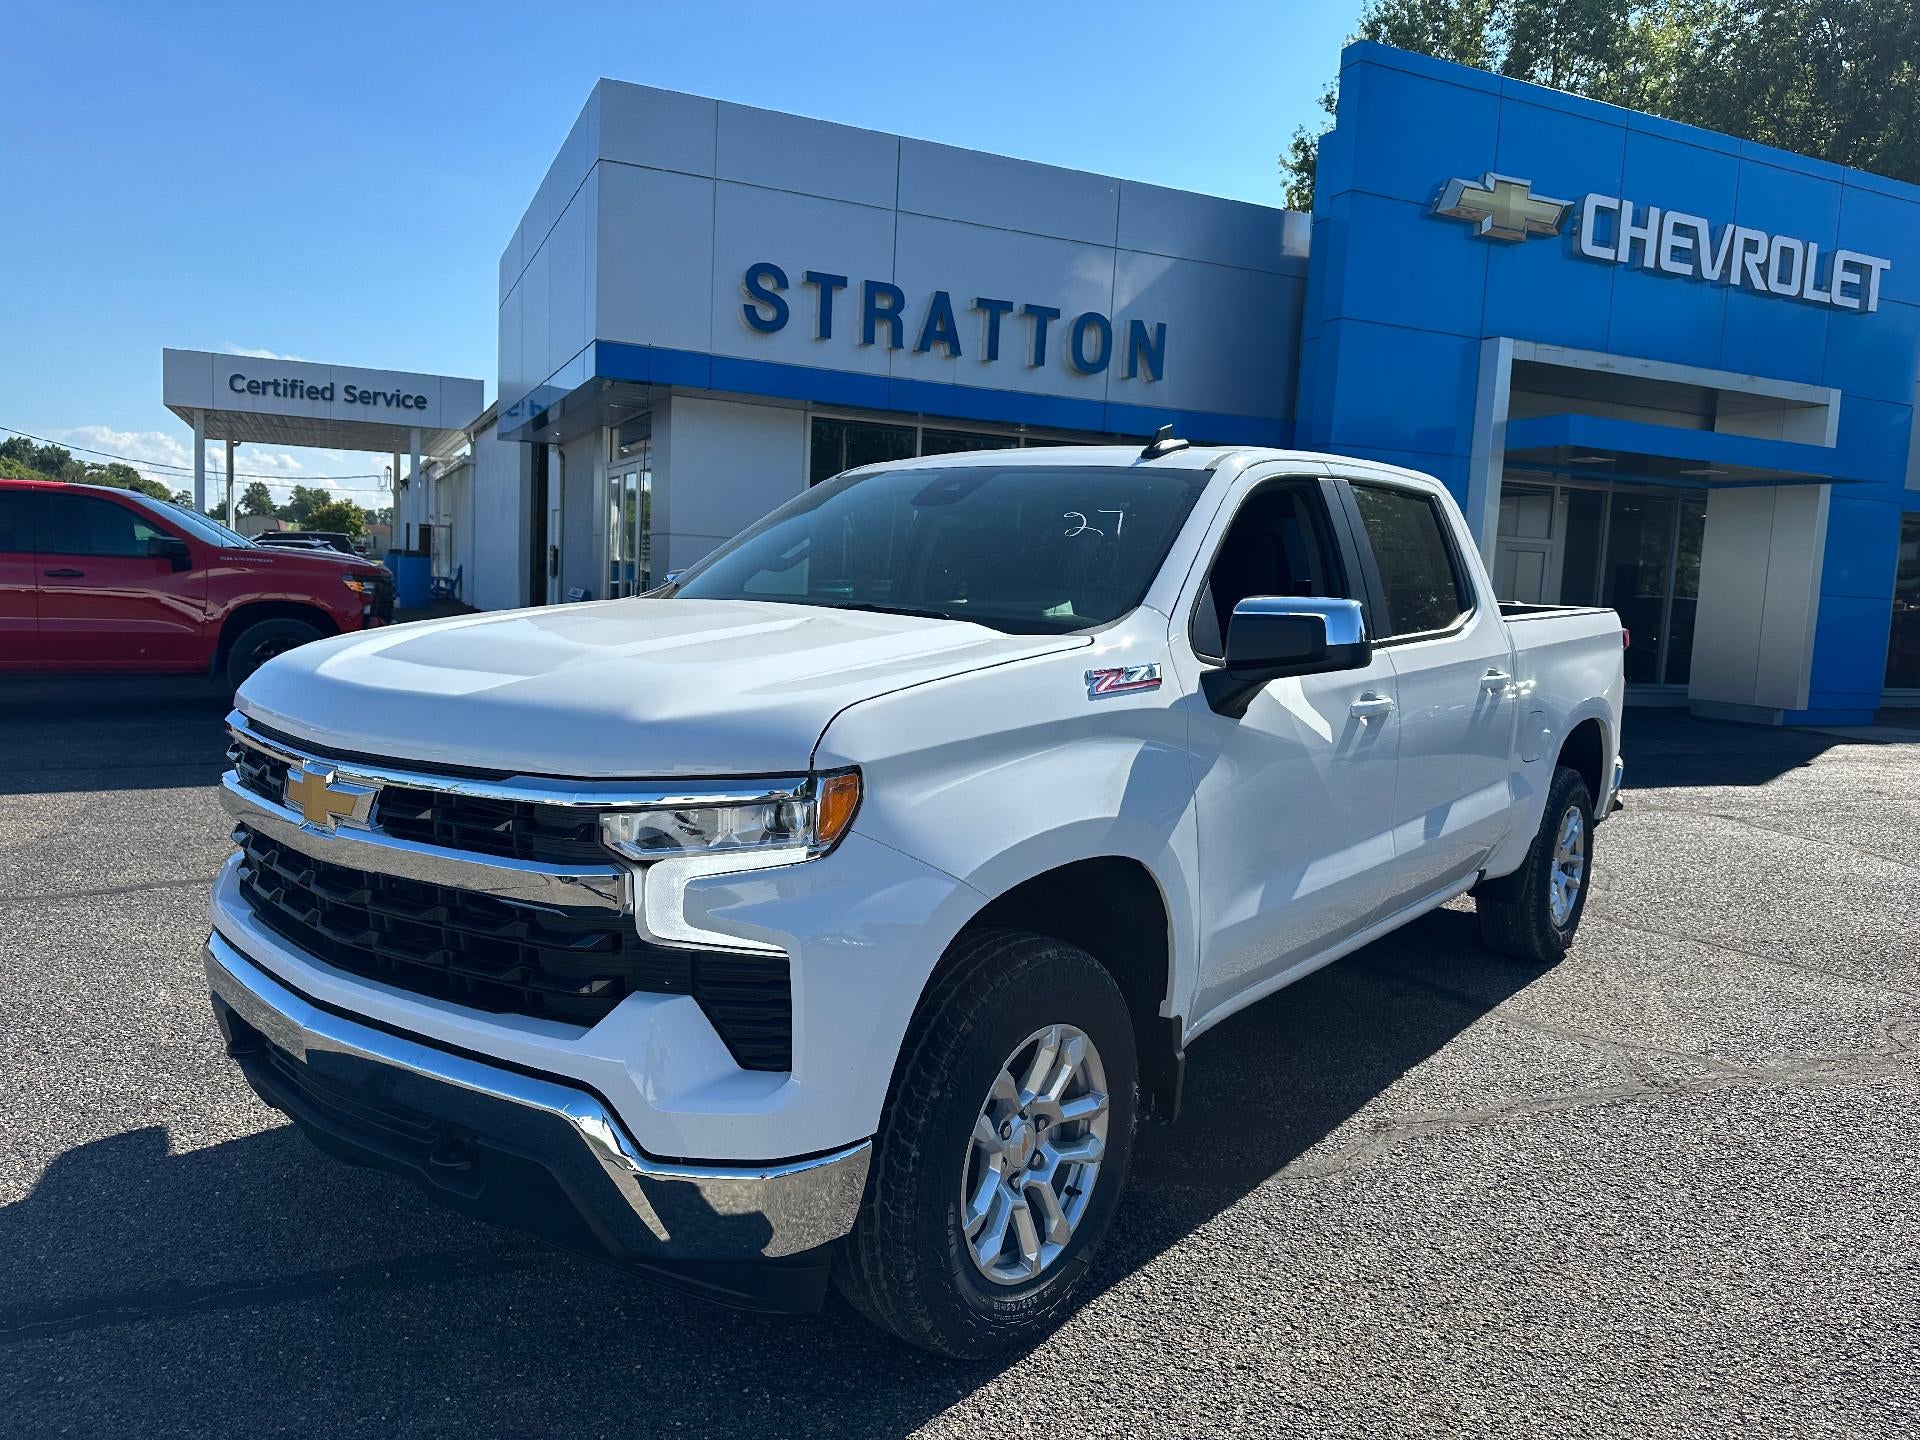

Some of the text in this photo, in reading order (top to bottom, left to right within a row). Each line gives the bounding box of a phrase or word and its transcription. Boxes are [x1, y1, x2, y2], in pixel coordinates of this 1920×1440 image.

[1579, 192, 1891, 312] CHEVROLET
[741, 262, 1168, 382] STRATTON
[228, 373, 428, 410] Certified Service
[1063, 509, 1124, 538] 27
[1088, 663, 1162, 695] Z71
